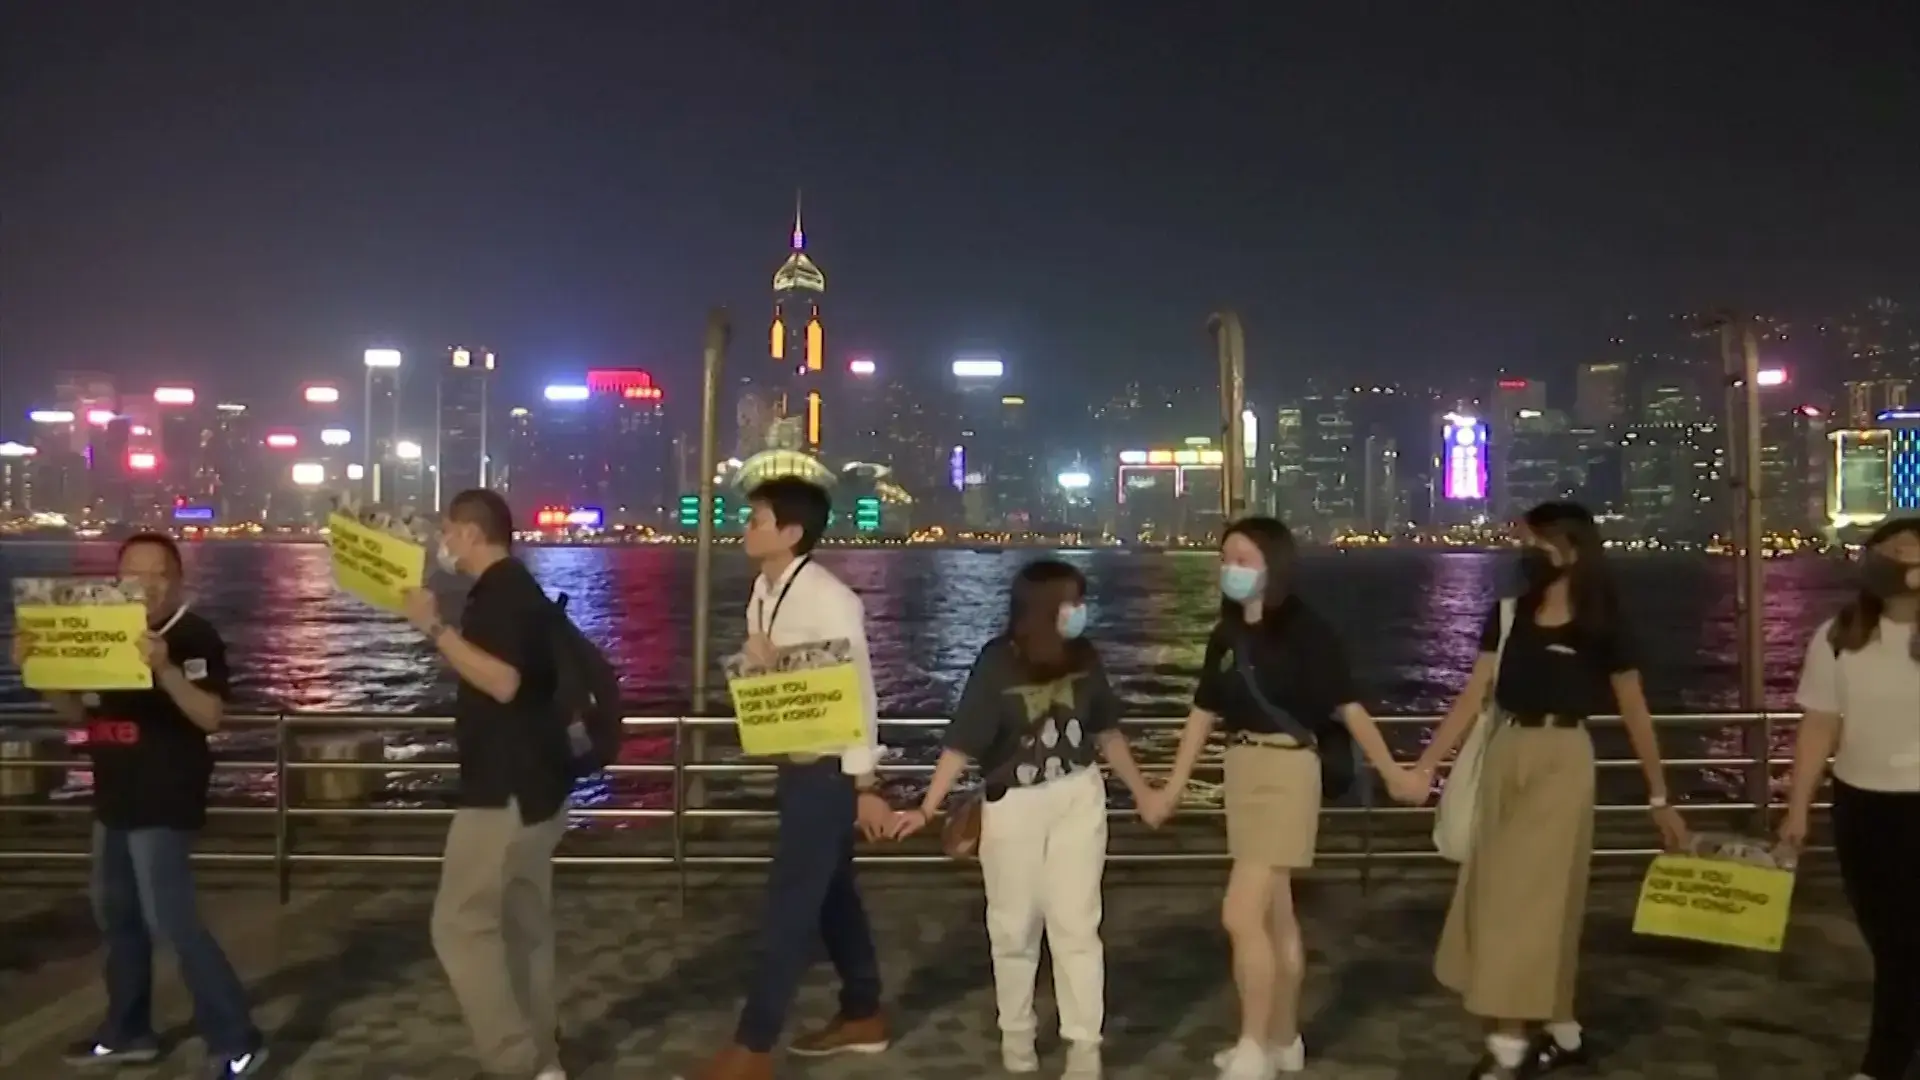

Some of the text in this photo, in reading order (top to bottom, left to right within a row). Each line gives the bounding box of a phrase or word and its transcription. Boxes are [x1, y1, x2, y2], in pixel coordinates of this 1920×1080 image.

[60, 616, 89, 628] YOU
[46, 630, 128, 643] SUPPORTING
[60, 646, 110, 658] KONG!
[737, 680, 808, 698] THANK YOU
[740, 689, 843, 712] FOR SUPPORTING
[742, 707, 828, 726] HONG KONG!
